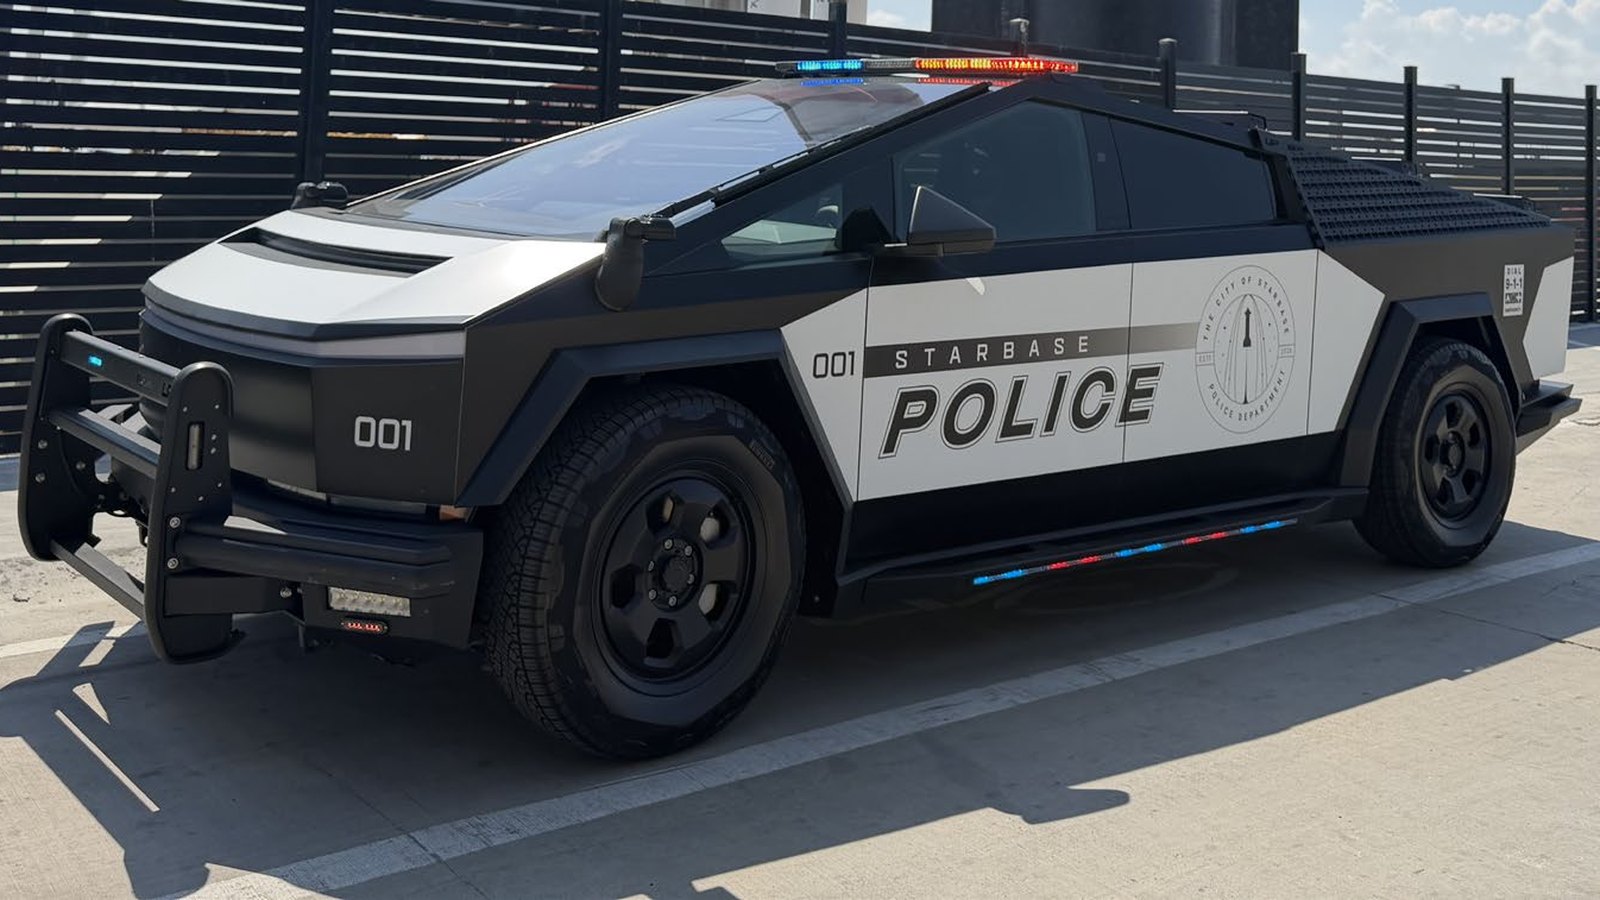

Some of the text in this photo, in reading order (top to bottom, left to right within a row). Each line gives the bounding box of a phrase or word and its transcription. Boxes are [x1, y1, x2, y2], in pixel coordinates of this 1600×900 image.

[1505, 278, 1523, 290] 9-1-1
[1507, 267, 1522, 275] DIAL
[1203, 275, 1290, 341] THE CITY OF STARBASE
[812, 350, 856, 379] 001
[894, 335, 1089, 370] STARBASE
[877, 361, 1165, 460] POLICE
[1209, 370, 1285, 421] POLICE DEPARTMENT
[354, 416, 412, 451] 001
